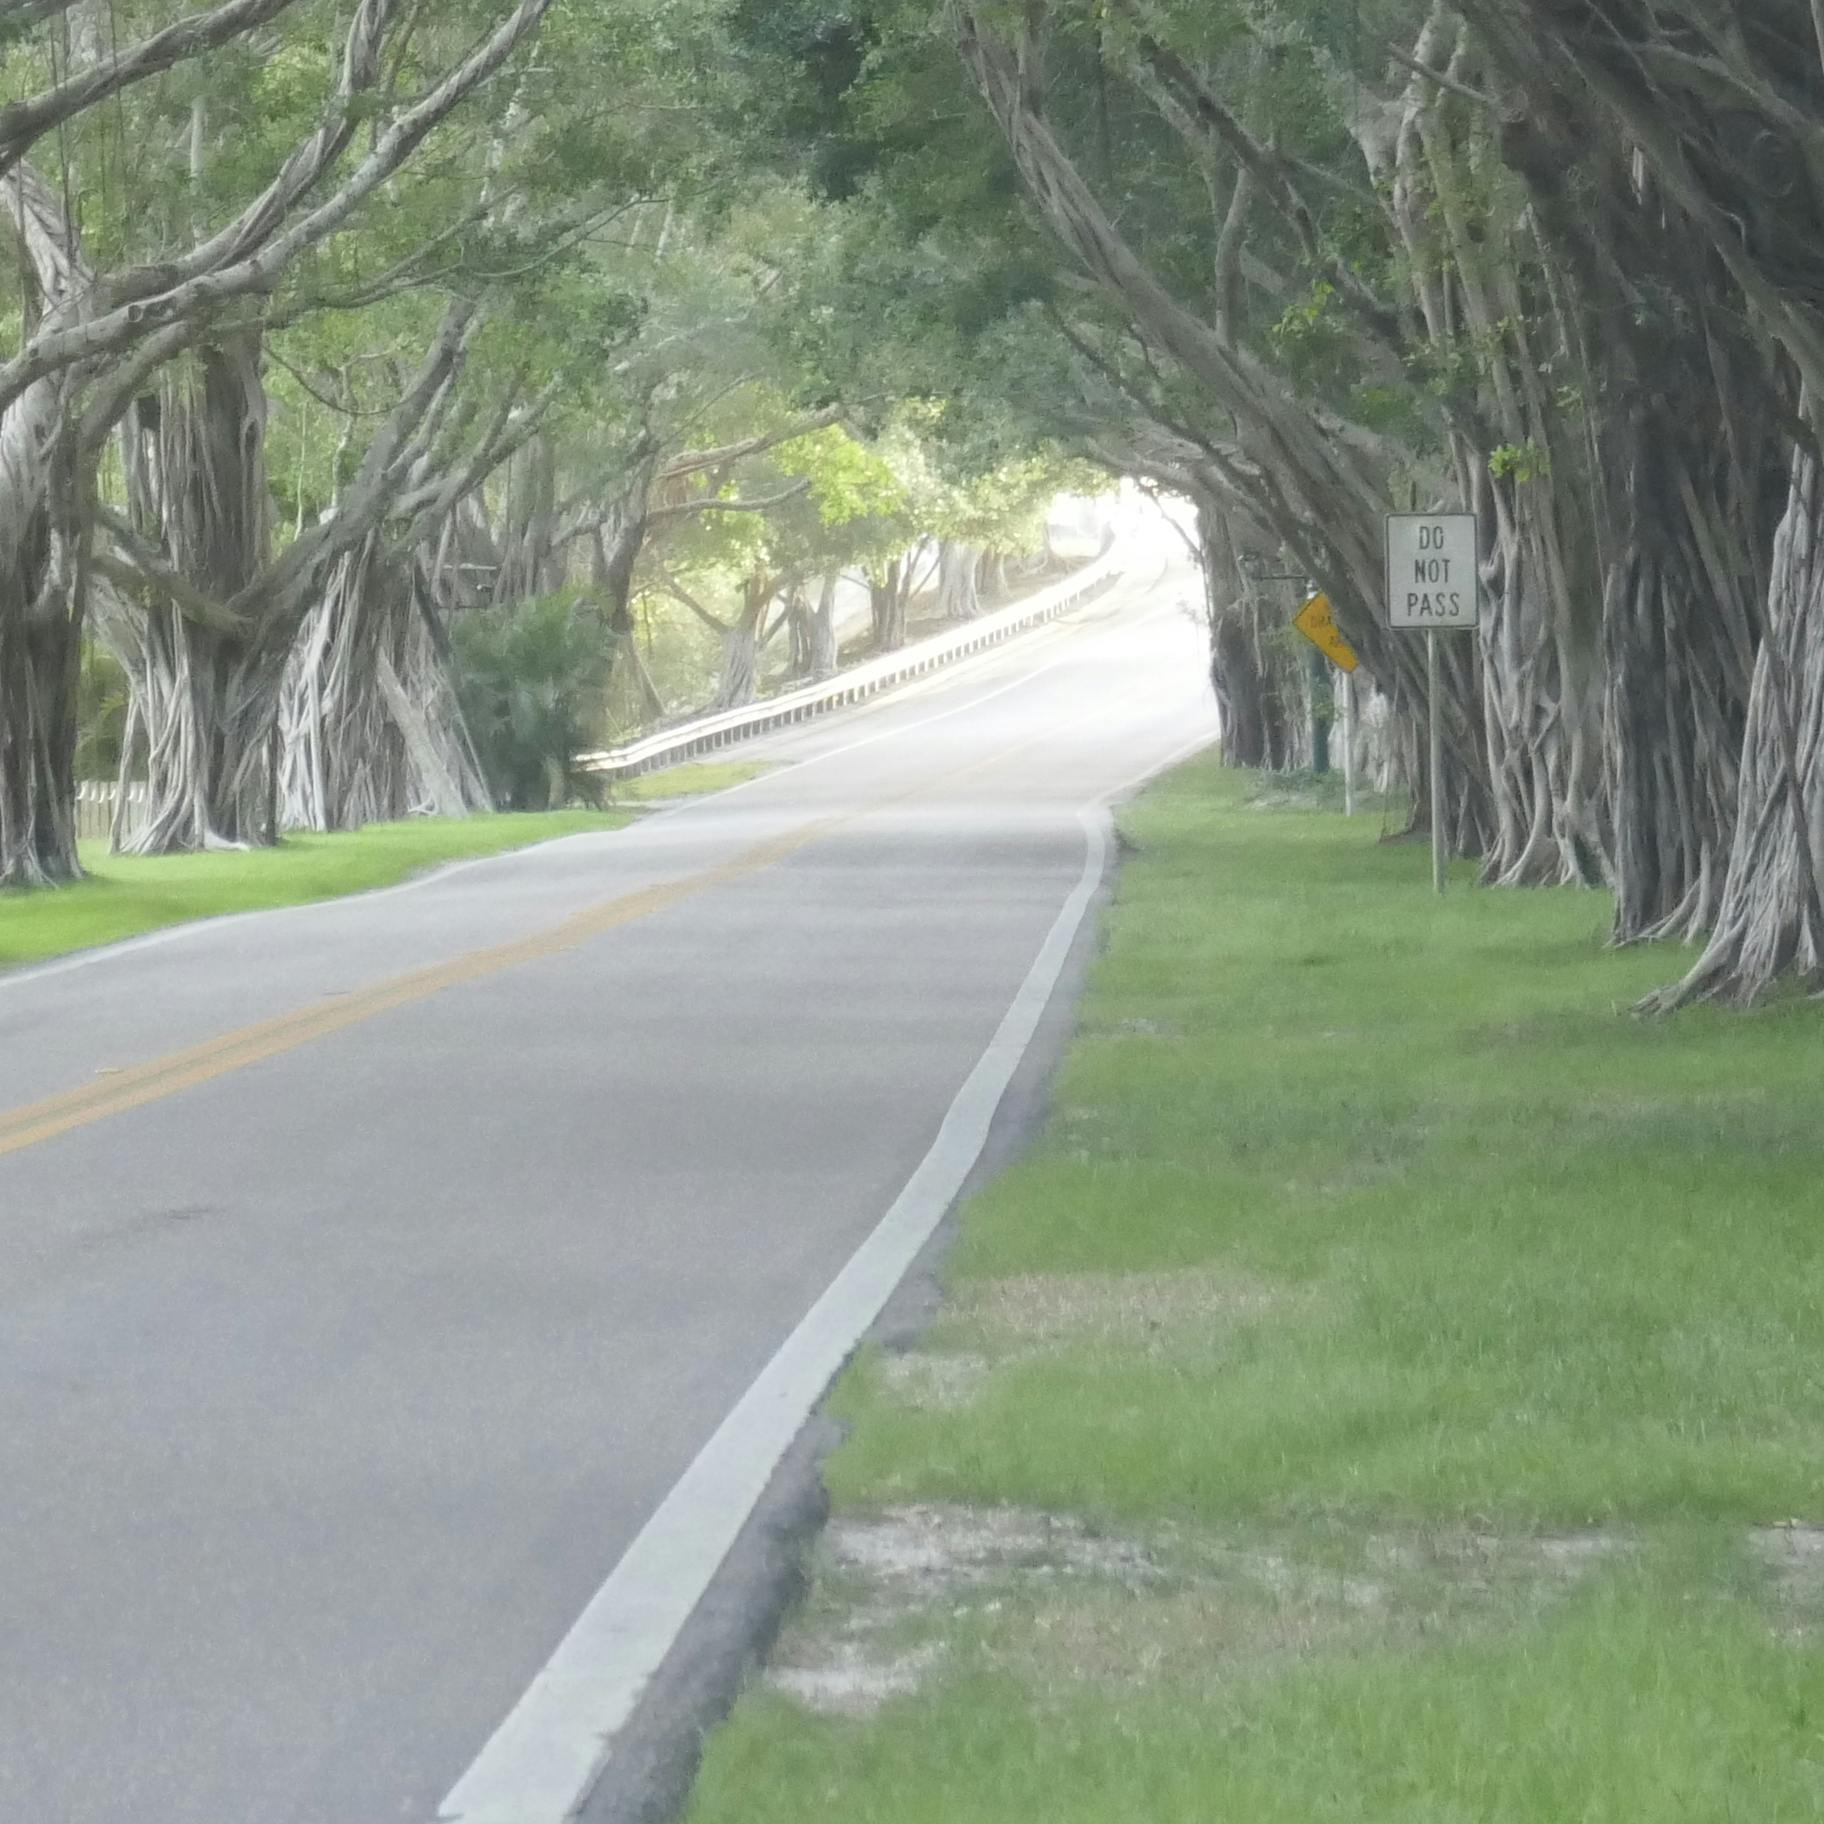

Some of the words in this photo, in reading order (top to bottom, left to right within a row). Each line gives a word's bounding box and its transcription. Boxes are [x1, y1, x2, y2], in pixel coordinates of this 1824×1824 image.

[1419, 525, 1444, 550] DO
[1415, 558, 1451, 584] NOT
[1406, 592, 1460, 617] PASS
